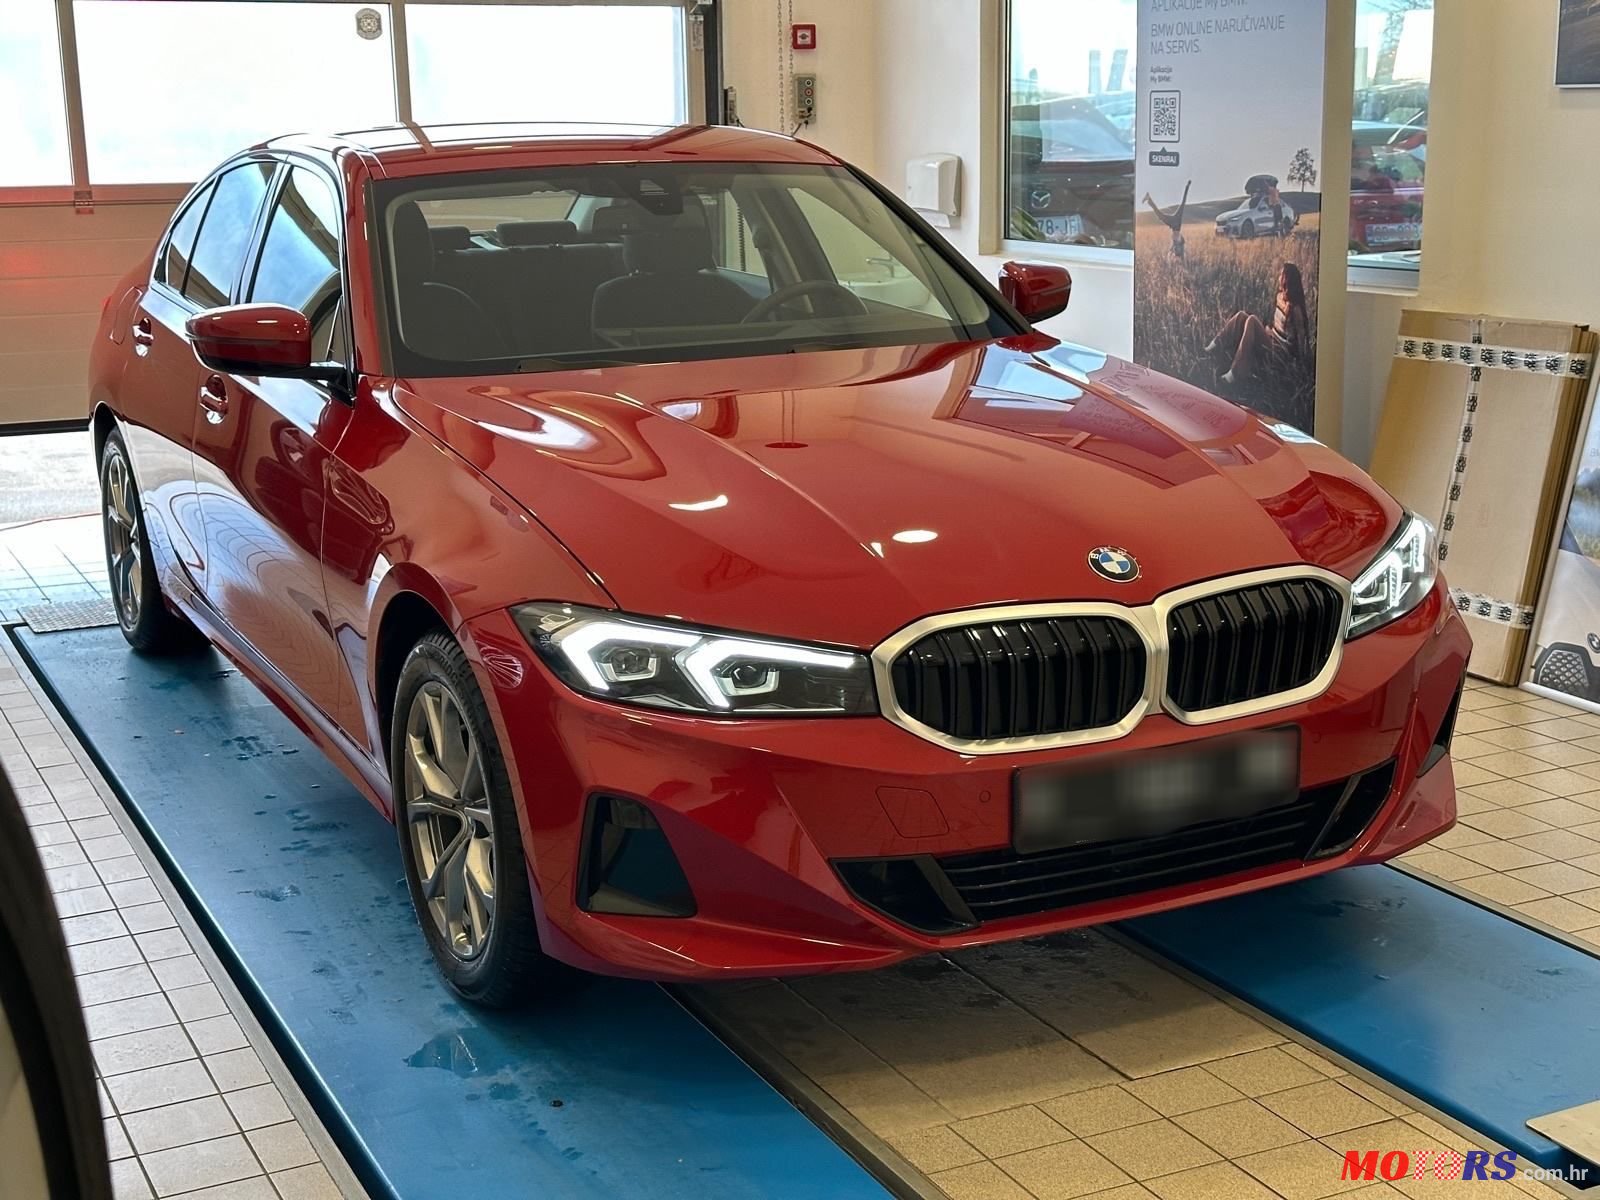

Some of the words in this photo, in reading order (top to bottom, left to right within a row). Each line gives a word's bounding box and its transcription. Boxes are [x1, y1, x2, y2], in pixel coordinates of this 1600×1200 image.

[1151, 0, 1202, 12] APLIKACIJE
[1151, 23, 1174, 37] BMW
[1175, 20, 1212, 36] ONLINE
[1214, 14, 1286, 32] NARUČIVANJE
[1151, 41, 1164, 54] NA
